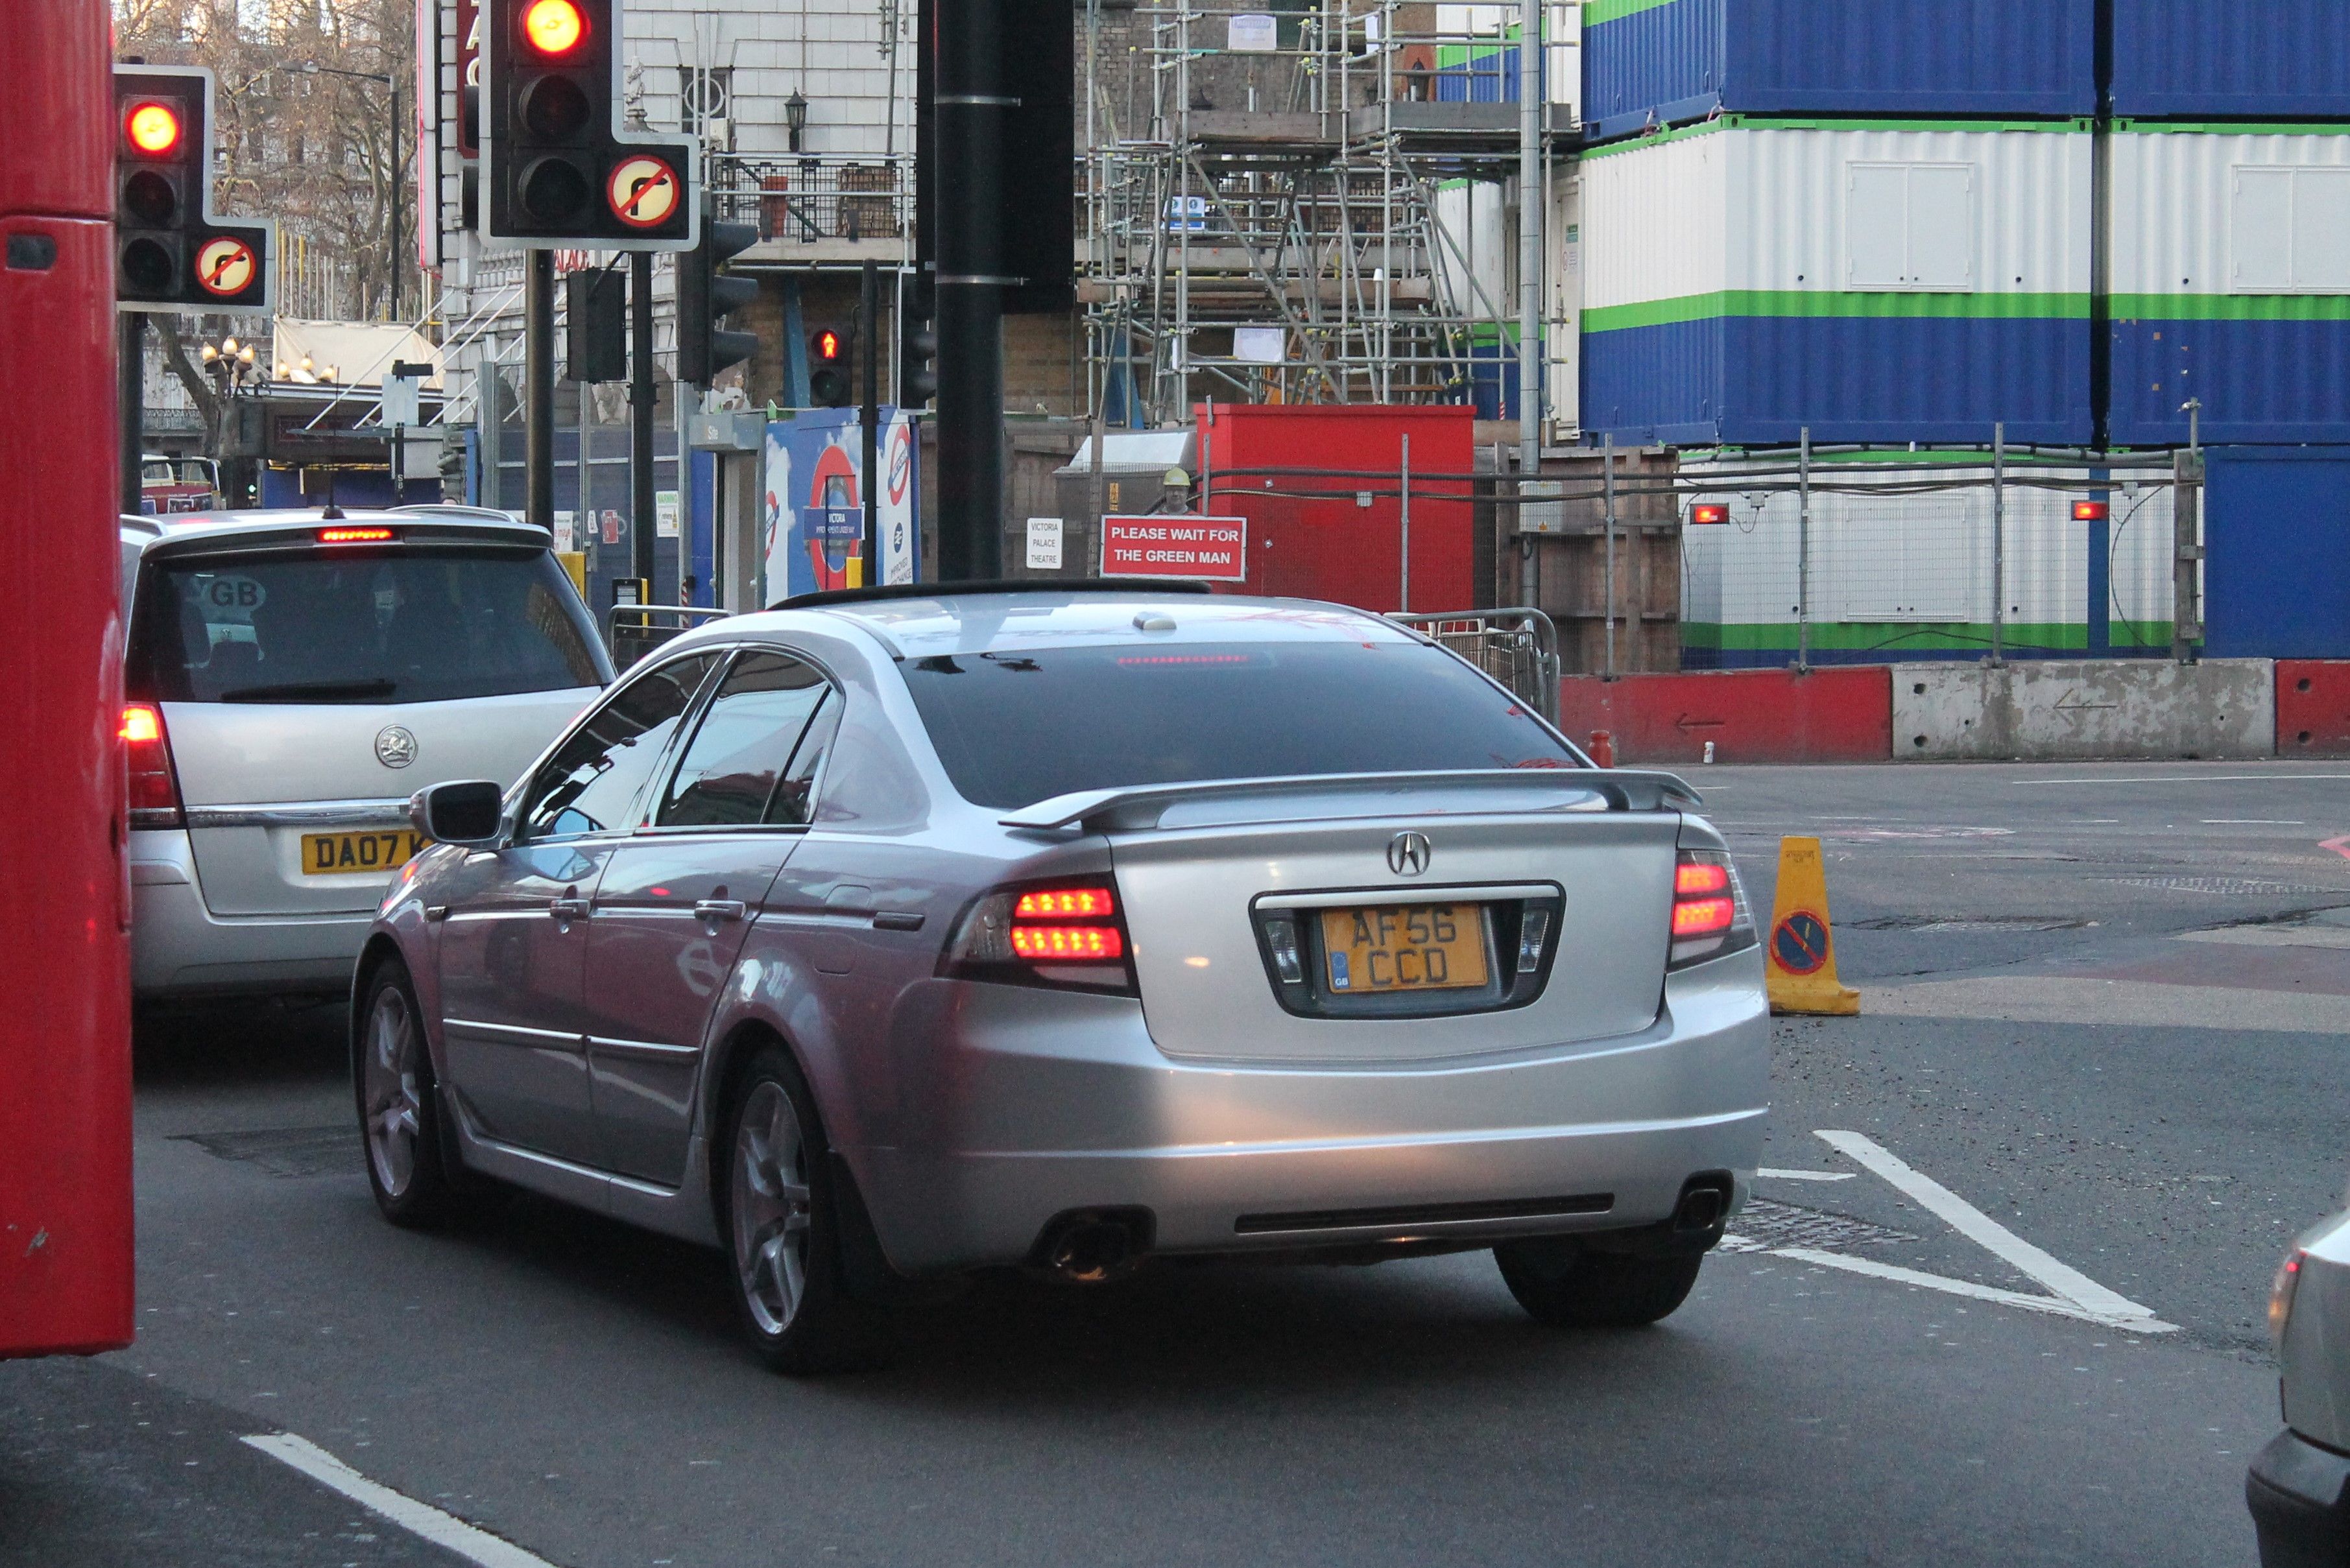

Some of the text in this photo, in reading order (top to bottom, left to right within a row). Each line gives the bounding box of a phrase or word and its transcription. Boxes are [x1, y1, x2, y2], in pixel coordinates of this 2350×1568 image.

[1031, 522, 1059, 531] VICTORIA
[1111, 527, 1239, 542] PLEASE WAIT FOR
[1033, 538, 1056, 548] PALACE
[1031, 554, 1057, 564] THEATRE
[1114, 549, 1231, 565] THE GREEN MAN
[211, 580, 258, 607] GB
[315, 835, 399, 868] DA07
[1351, 908, 1457, 947] AF56
[1367, 947, 1448, 986] CCD
[1335, 977, 1349, 986] GB
